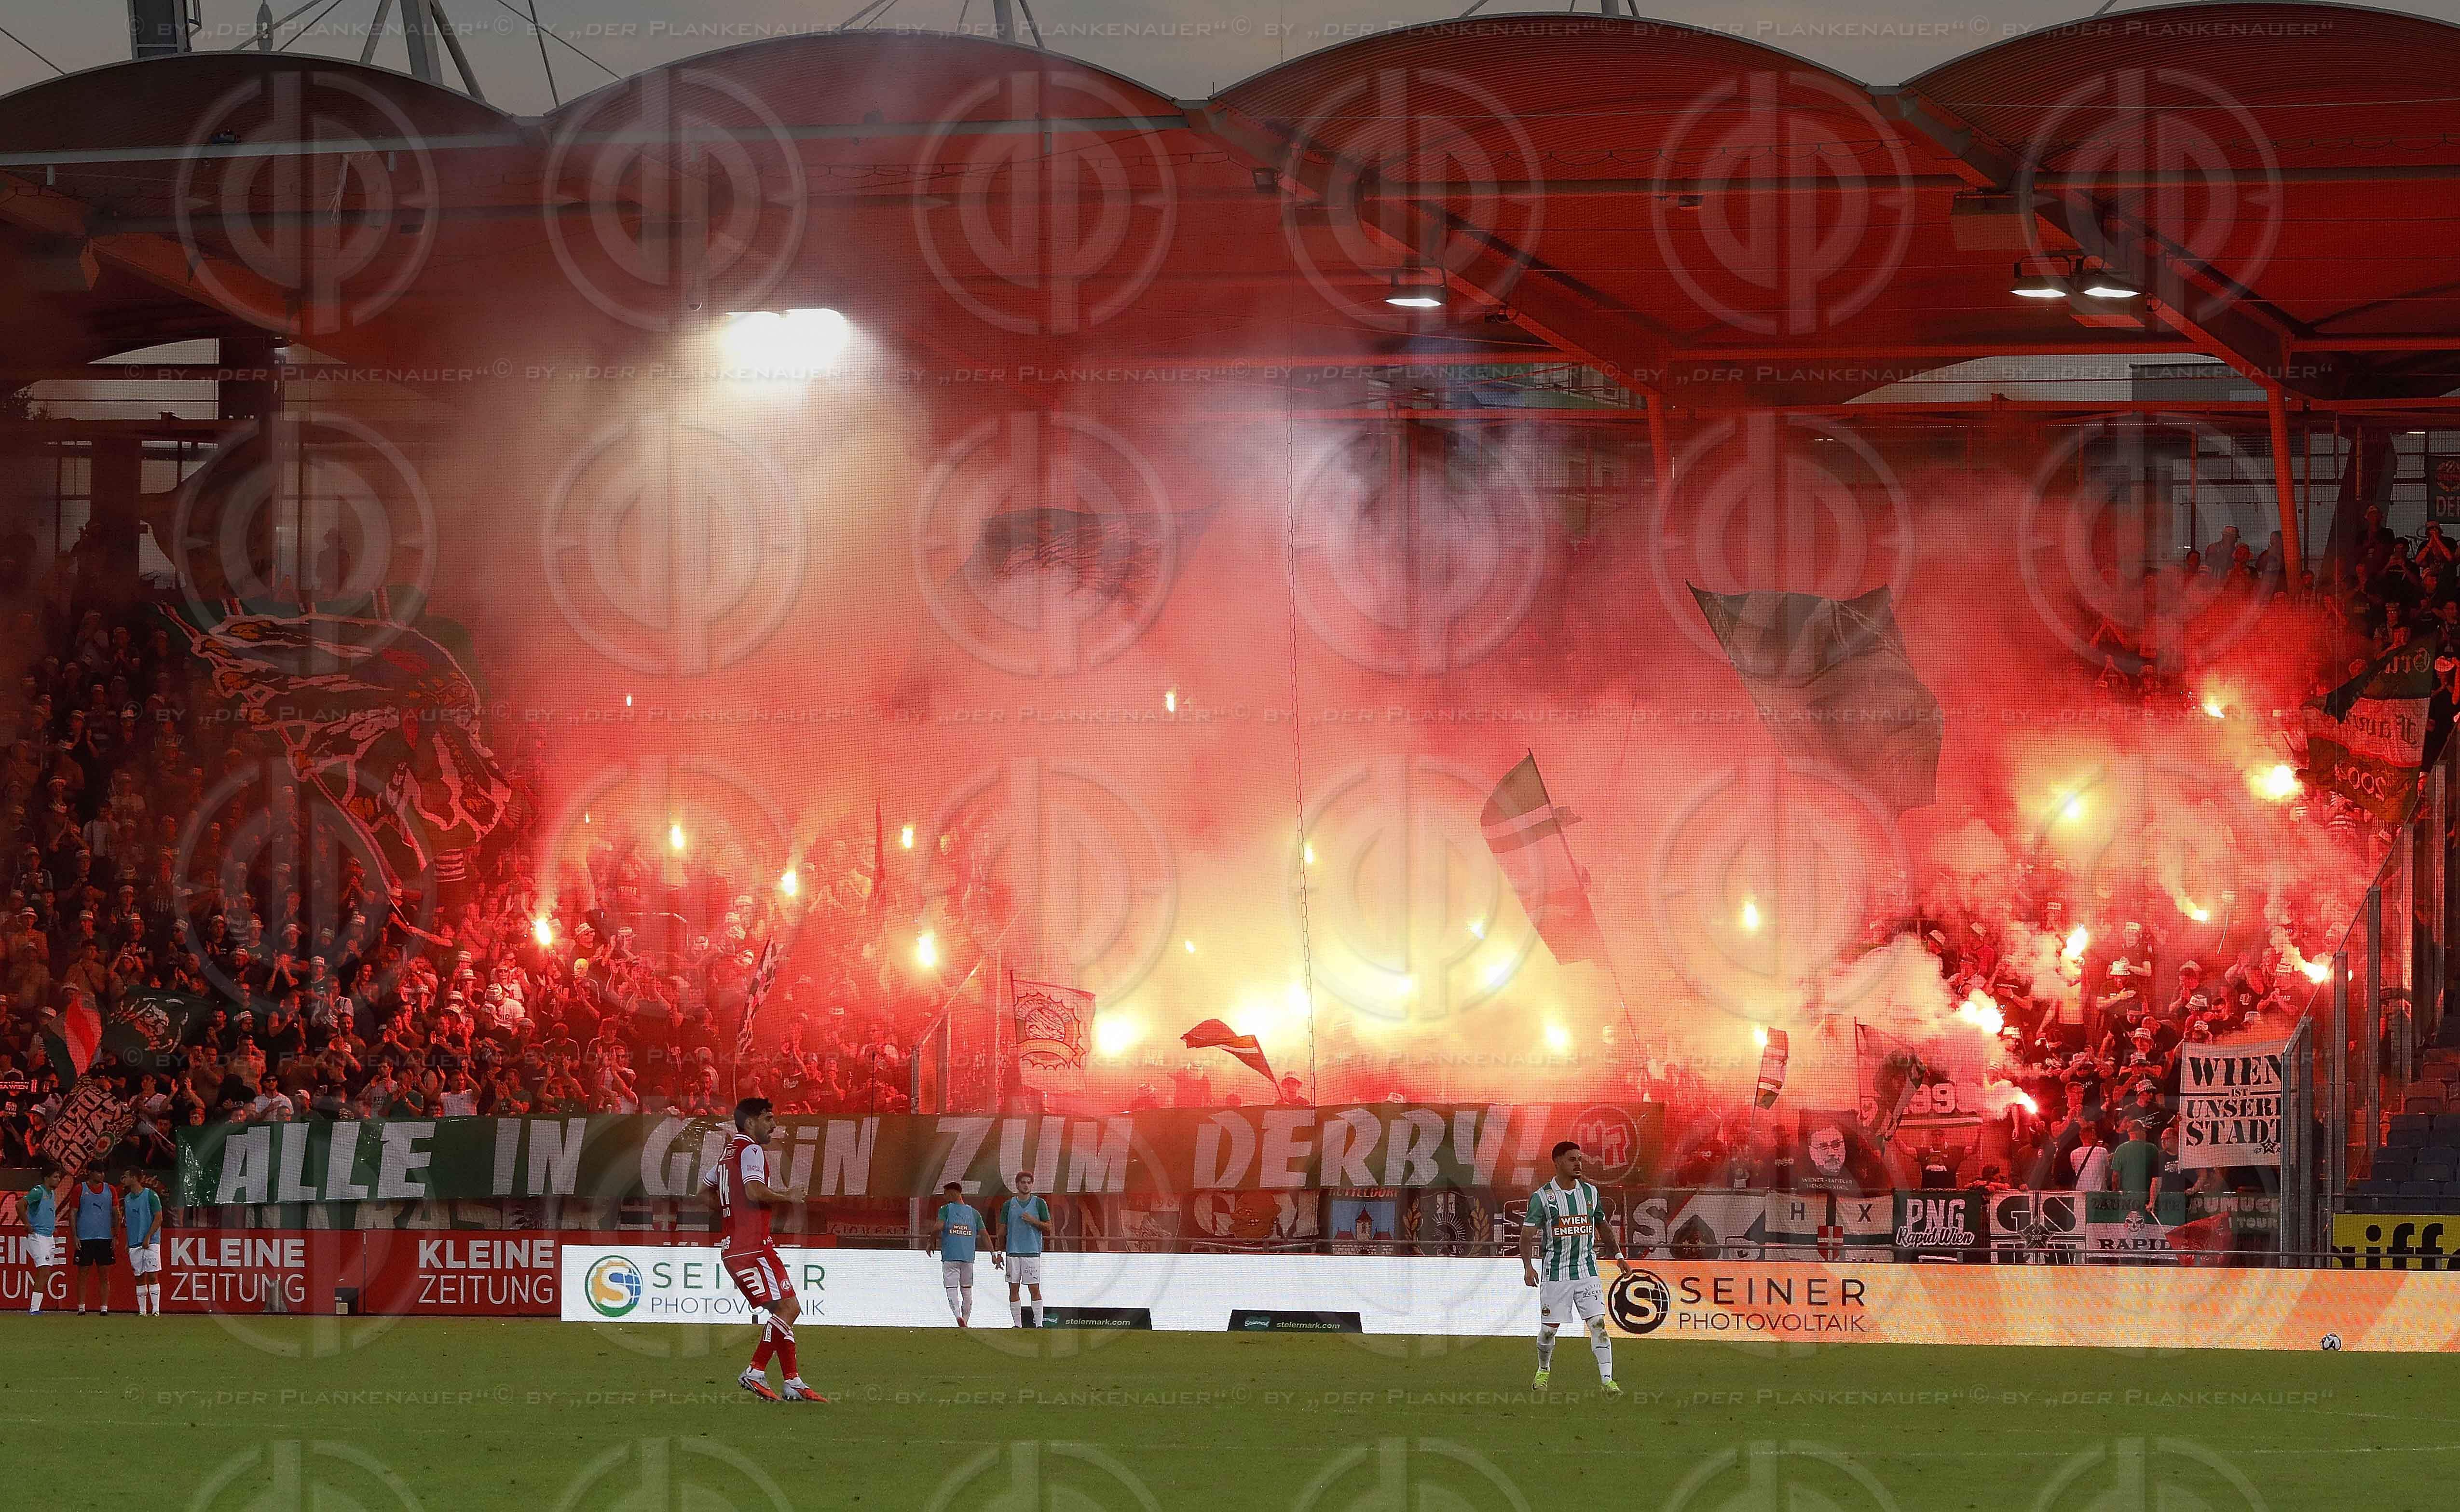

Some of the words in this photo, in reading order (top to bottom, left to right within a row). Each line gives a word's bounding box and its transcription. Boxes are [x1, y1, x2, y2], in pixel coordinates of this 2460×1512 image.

[2231, 1089, 2248, 1097] IST
[215, 1122, 436, 1203] ALLE
[492, 1117, 587, 1195] IN
[932, 1116, 1133, 1194] ZUM
[1193, 1105, 1552, 1187] DERBY!
[1560, 1216, 1587, 1225] WIEN
[1790, 1202, 1804, 1221] H
[1858, 1204, 1872, 1223] X
[1906, 1199, 1966, 1233] PNG
[1554, 1226, 1593, 1236] ENERGIE
[1896, 1226, 1938, 1248] Rapid
[1939, 1227, 1974, 1246] Wien
[171, 1238, 305, 1267] KLEINE
[418, 1240, 554, 1269] KLEINE
[171, 1272, 305, 1303] ZEITUNG
[418, 1274, 553, 1304] ZEITUNG
[653, 1262, 825, 1291] SEIR
[1681, 1277, 1865, 1306] SEINER
[1680, 1313, 1866, 1332] PHOTOVOLTAIK
